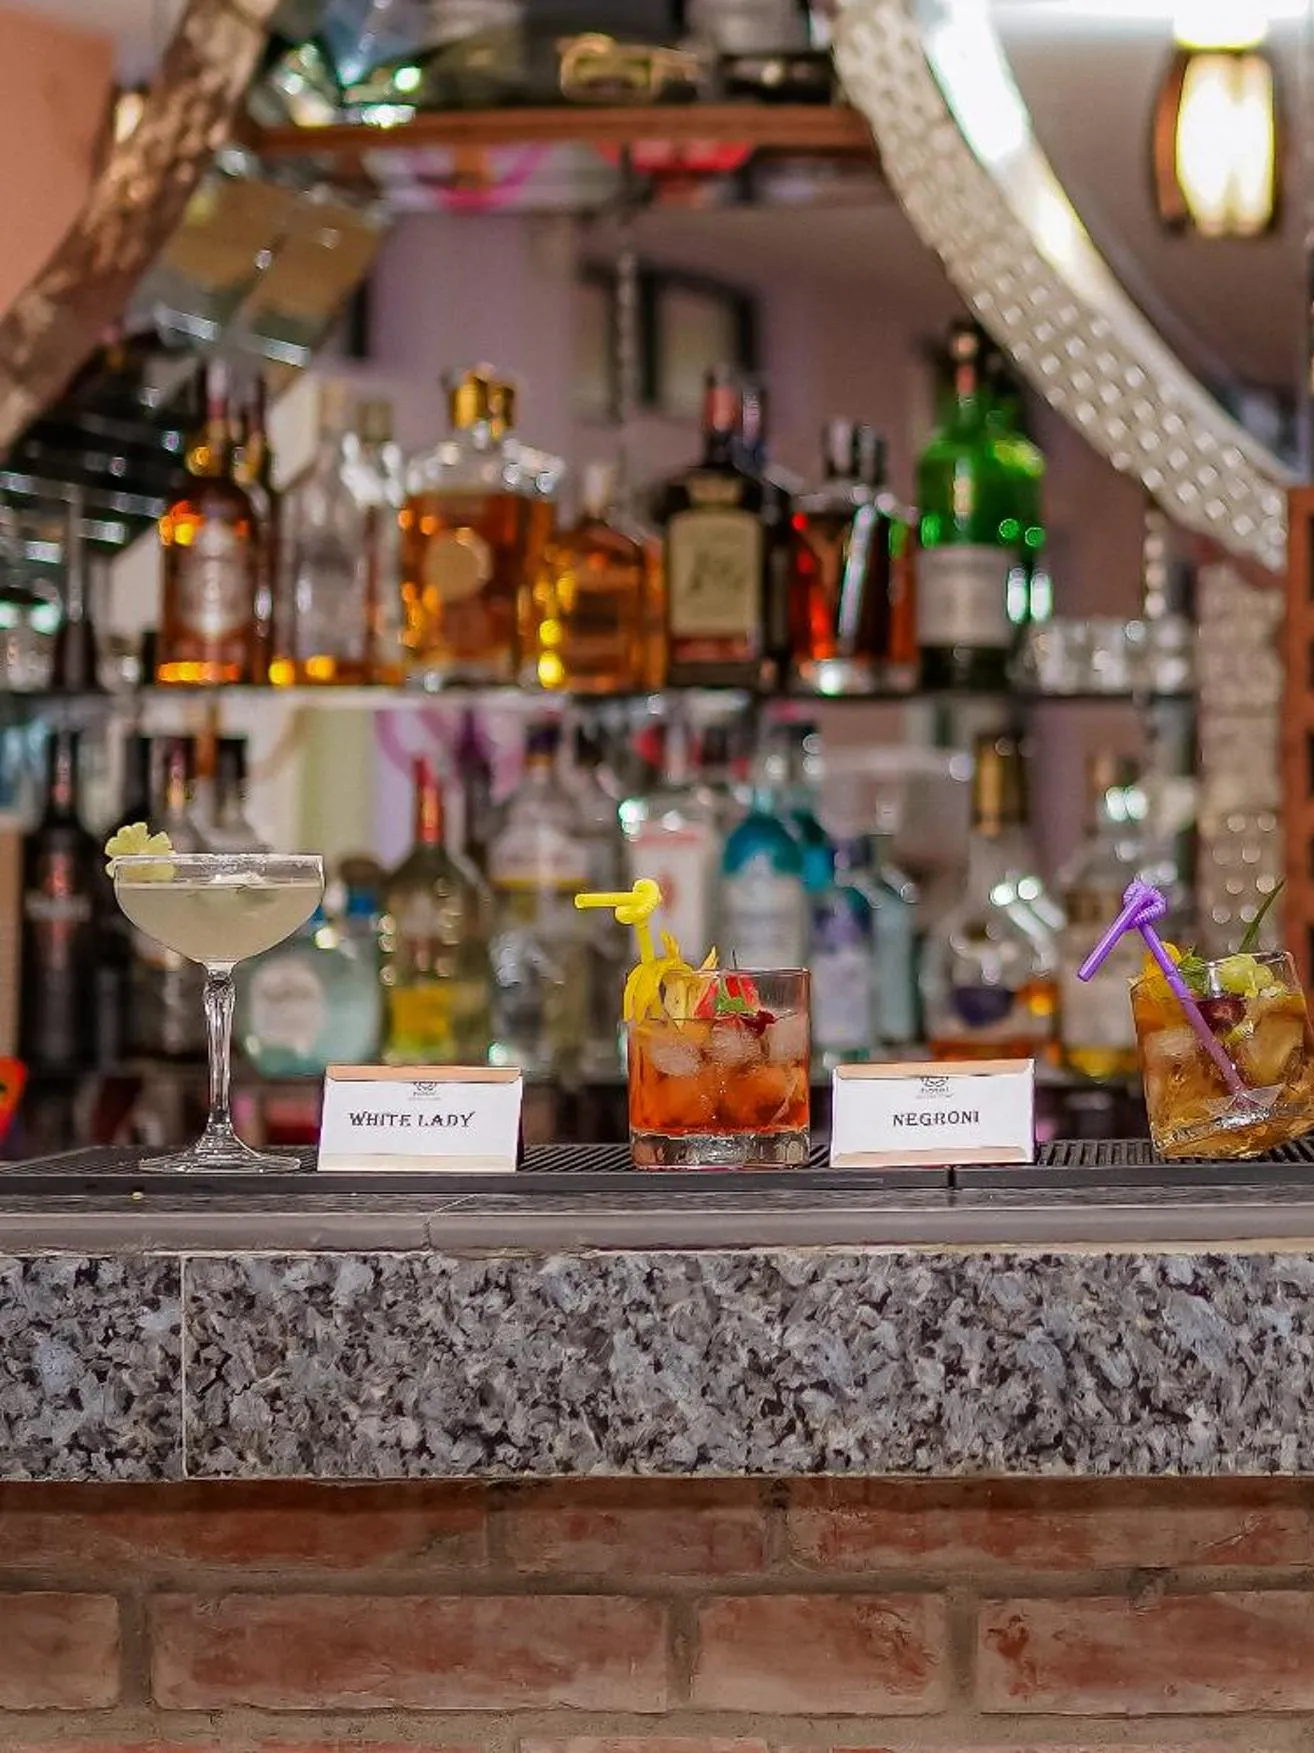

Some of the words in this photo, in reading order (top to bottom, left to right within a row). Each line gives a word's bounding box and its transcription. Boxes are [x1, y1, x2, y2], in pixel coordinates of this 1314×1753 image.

[350, 1111, 411, 1127] WHITE
[418, 1111, 476, 1127] LADY
[893, 1111, 980, 1127] NEGRONI
